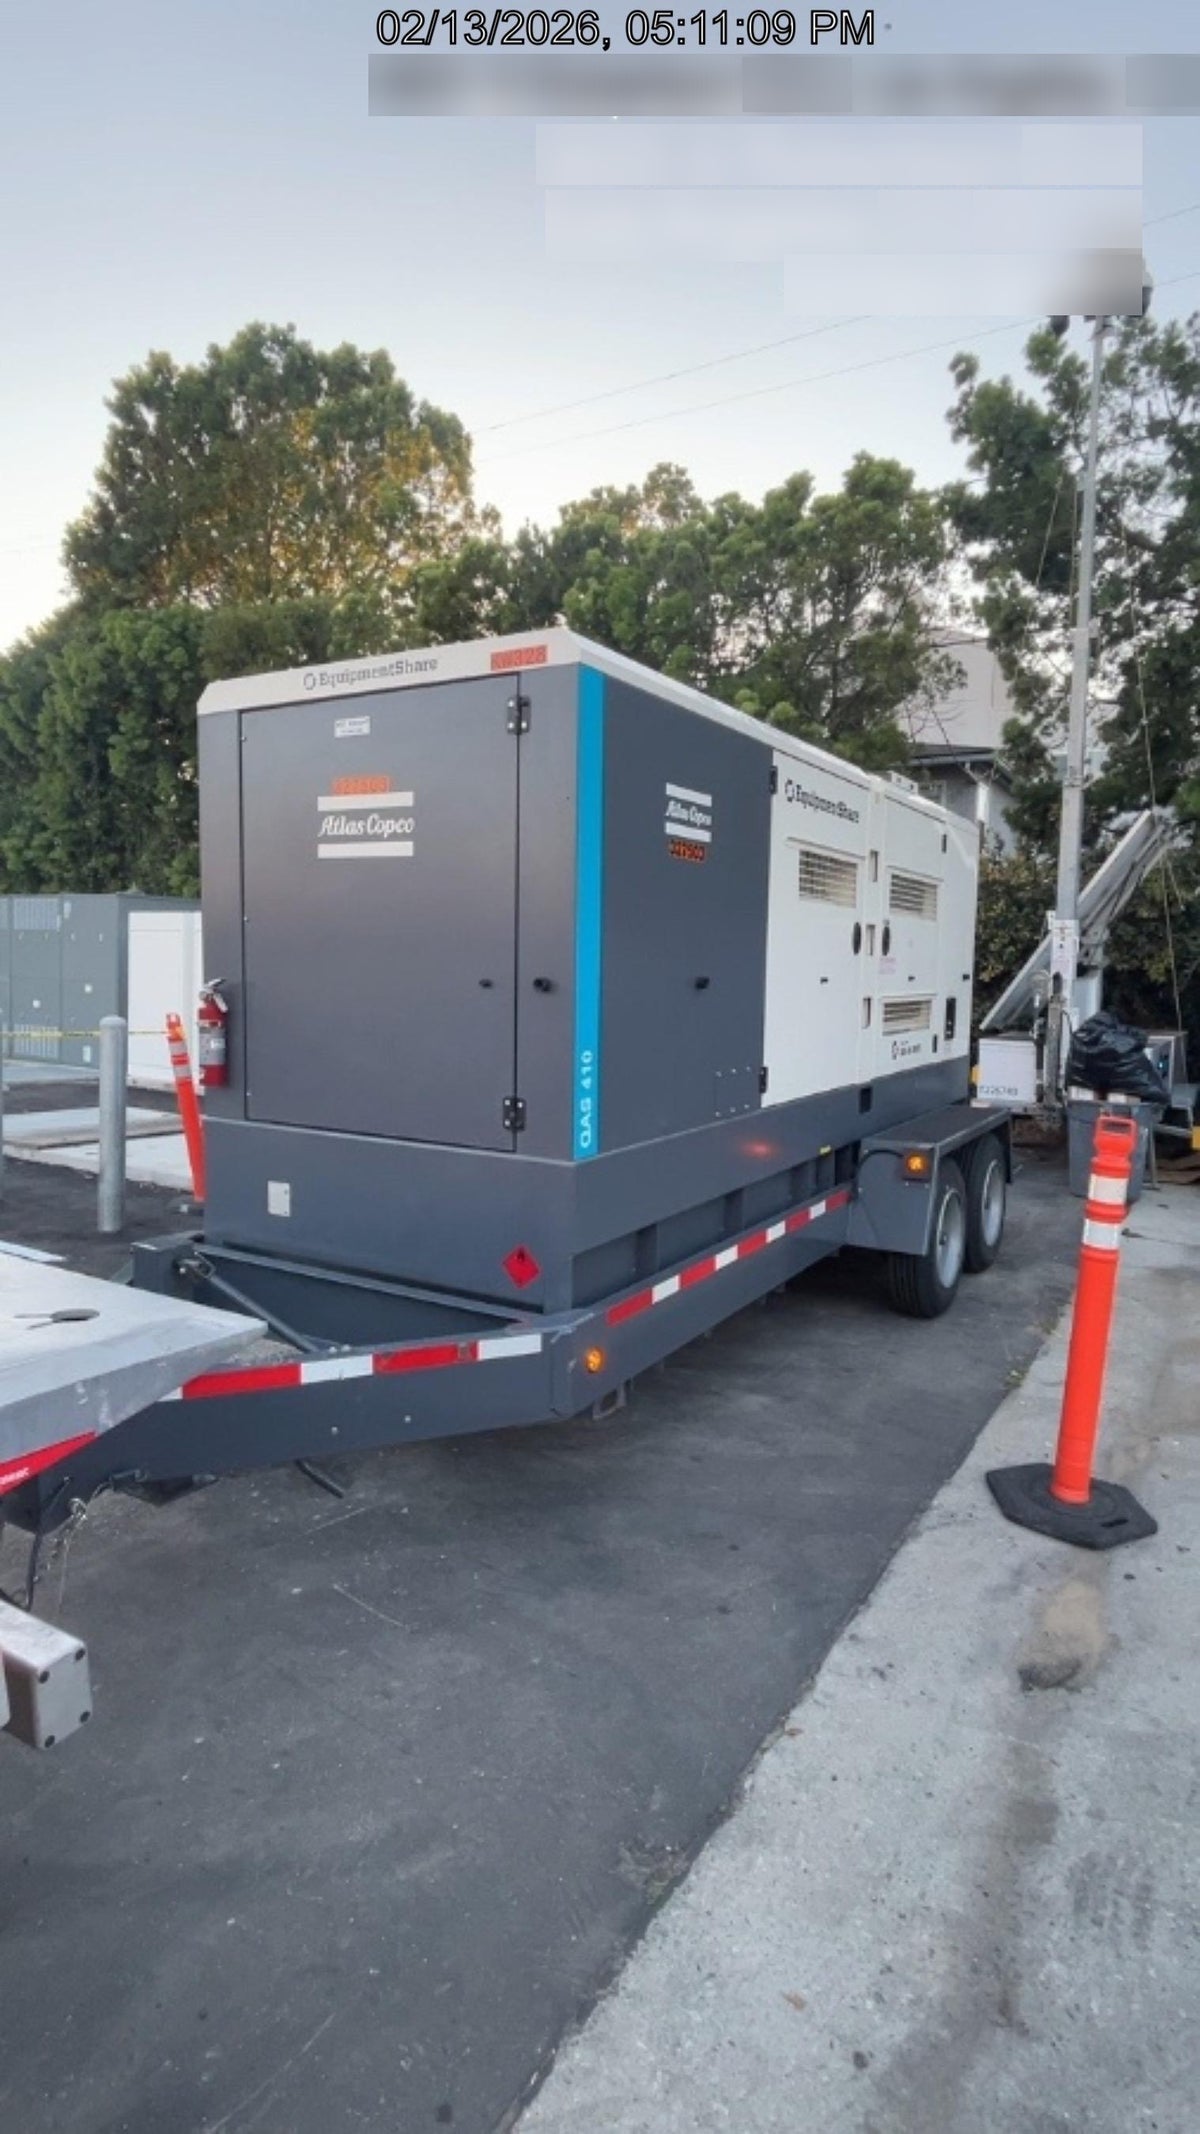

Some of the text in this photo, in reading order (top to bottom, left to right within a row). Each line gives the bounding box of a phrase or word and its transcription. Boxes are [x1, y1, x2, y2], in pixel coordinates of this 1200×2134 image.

[318, 658, 438, 688] EquipmentShare
[664, 800, 689, 821] Atlas
[796, 783, 859, 824] EquipmentShare
[317, 813, 416, 838] Atlas Copco
[580, 1049, 593, 1149] QAS 410
